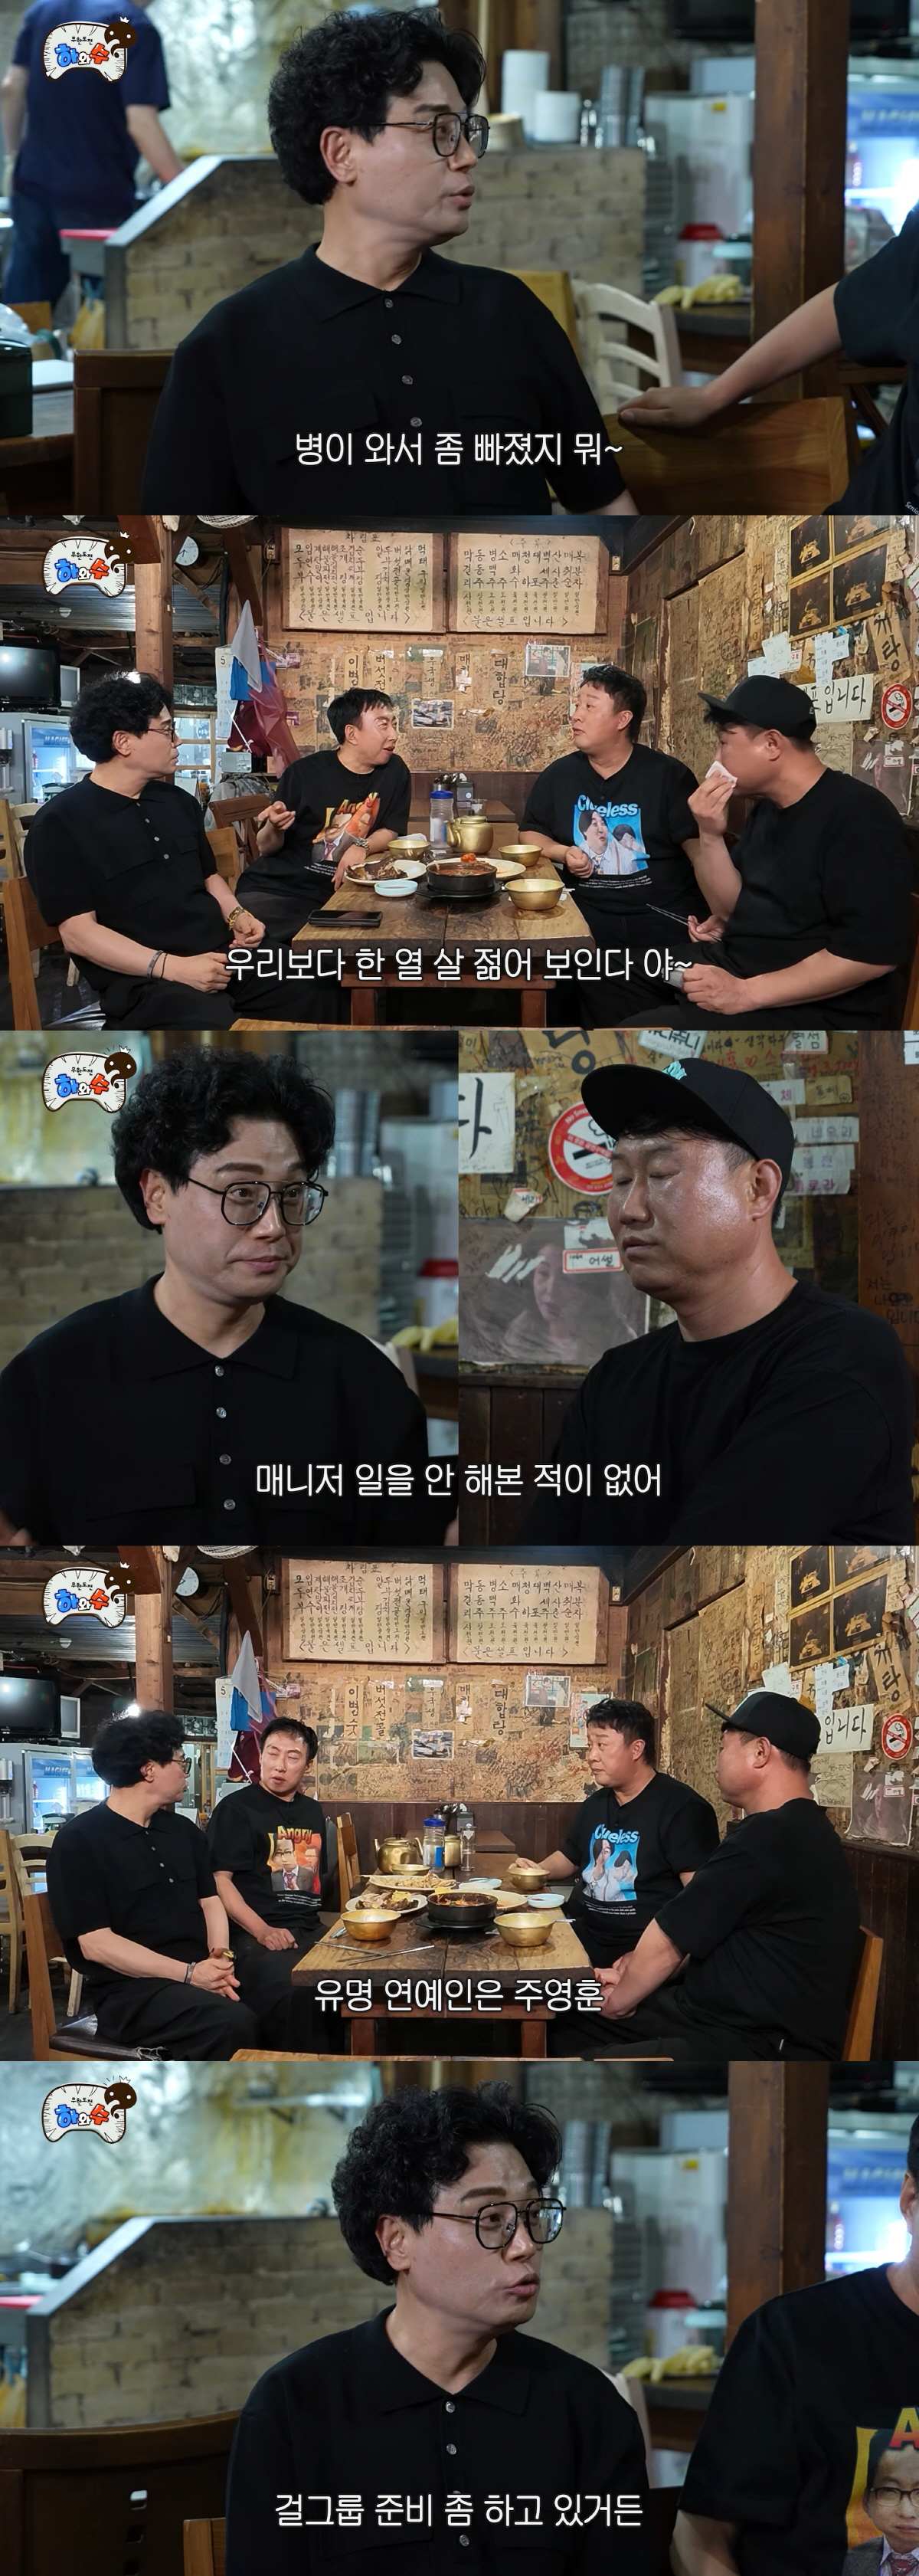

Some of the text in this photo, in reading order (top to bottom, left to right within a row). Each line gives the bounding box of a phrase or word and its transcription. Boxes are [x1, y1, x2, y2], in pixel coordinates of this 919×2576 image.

[345, 532, 381, 543] 차림표
[293, 544, 306, 584] 모두부
[473, 549, 485, 588] 동동주
[486, 548, 497, 588] 병맥주
[497, 550, 509, 589] 소주
[509, 550, 521, 588] 매화수
[522, 550, 531, 588] 청하
[530, 551, 541, 588] 대포
[539, 550, 551, 589] 백세주
[551, 550, 562, 588] 산사춘
[561, 551, 573, 588] 매취순
[572, 550, 584, 589] 복분자
[375, 654, 386, 691] 버섯전
[345, 1562, 381, 1574] 차림표
[293, 1575, 306, 1614] 모두부
[473, 1579, 485, 1619] 동동주
[486, 1578, 497, 1619] 병맥주
[497, 1581, 509, 1620] 소주
[509, 1581, 521, 1619] 매화수
[522, 1581, 531, 1619] 청하
[530, 1581, 541, 1618] 대포
[539, 1581, 551, 1620] 백세주
[551, 1581, 562, 1619] 산사춘
[561, 1581, 573, 1619] 매취순
[572, 1581, 584, 1620] 복분자
[824, 1707, 866, 1745] 입니다
[277, 1825, 312, 1844] Angry
